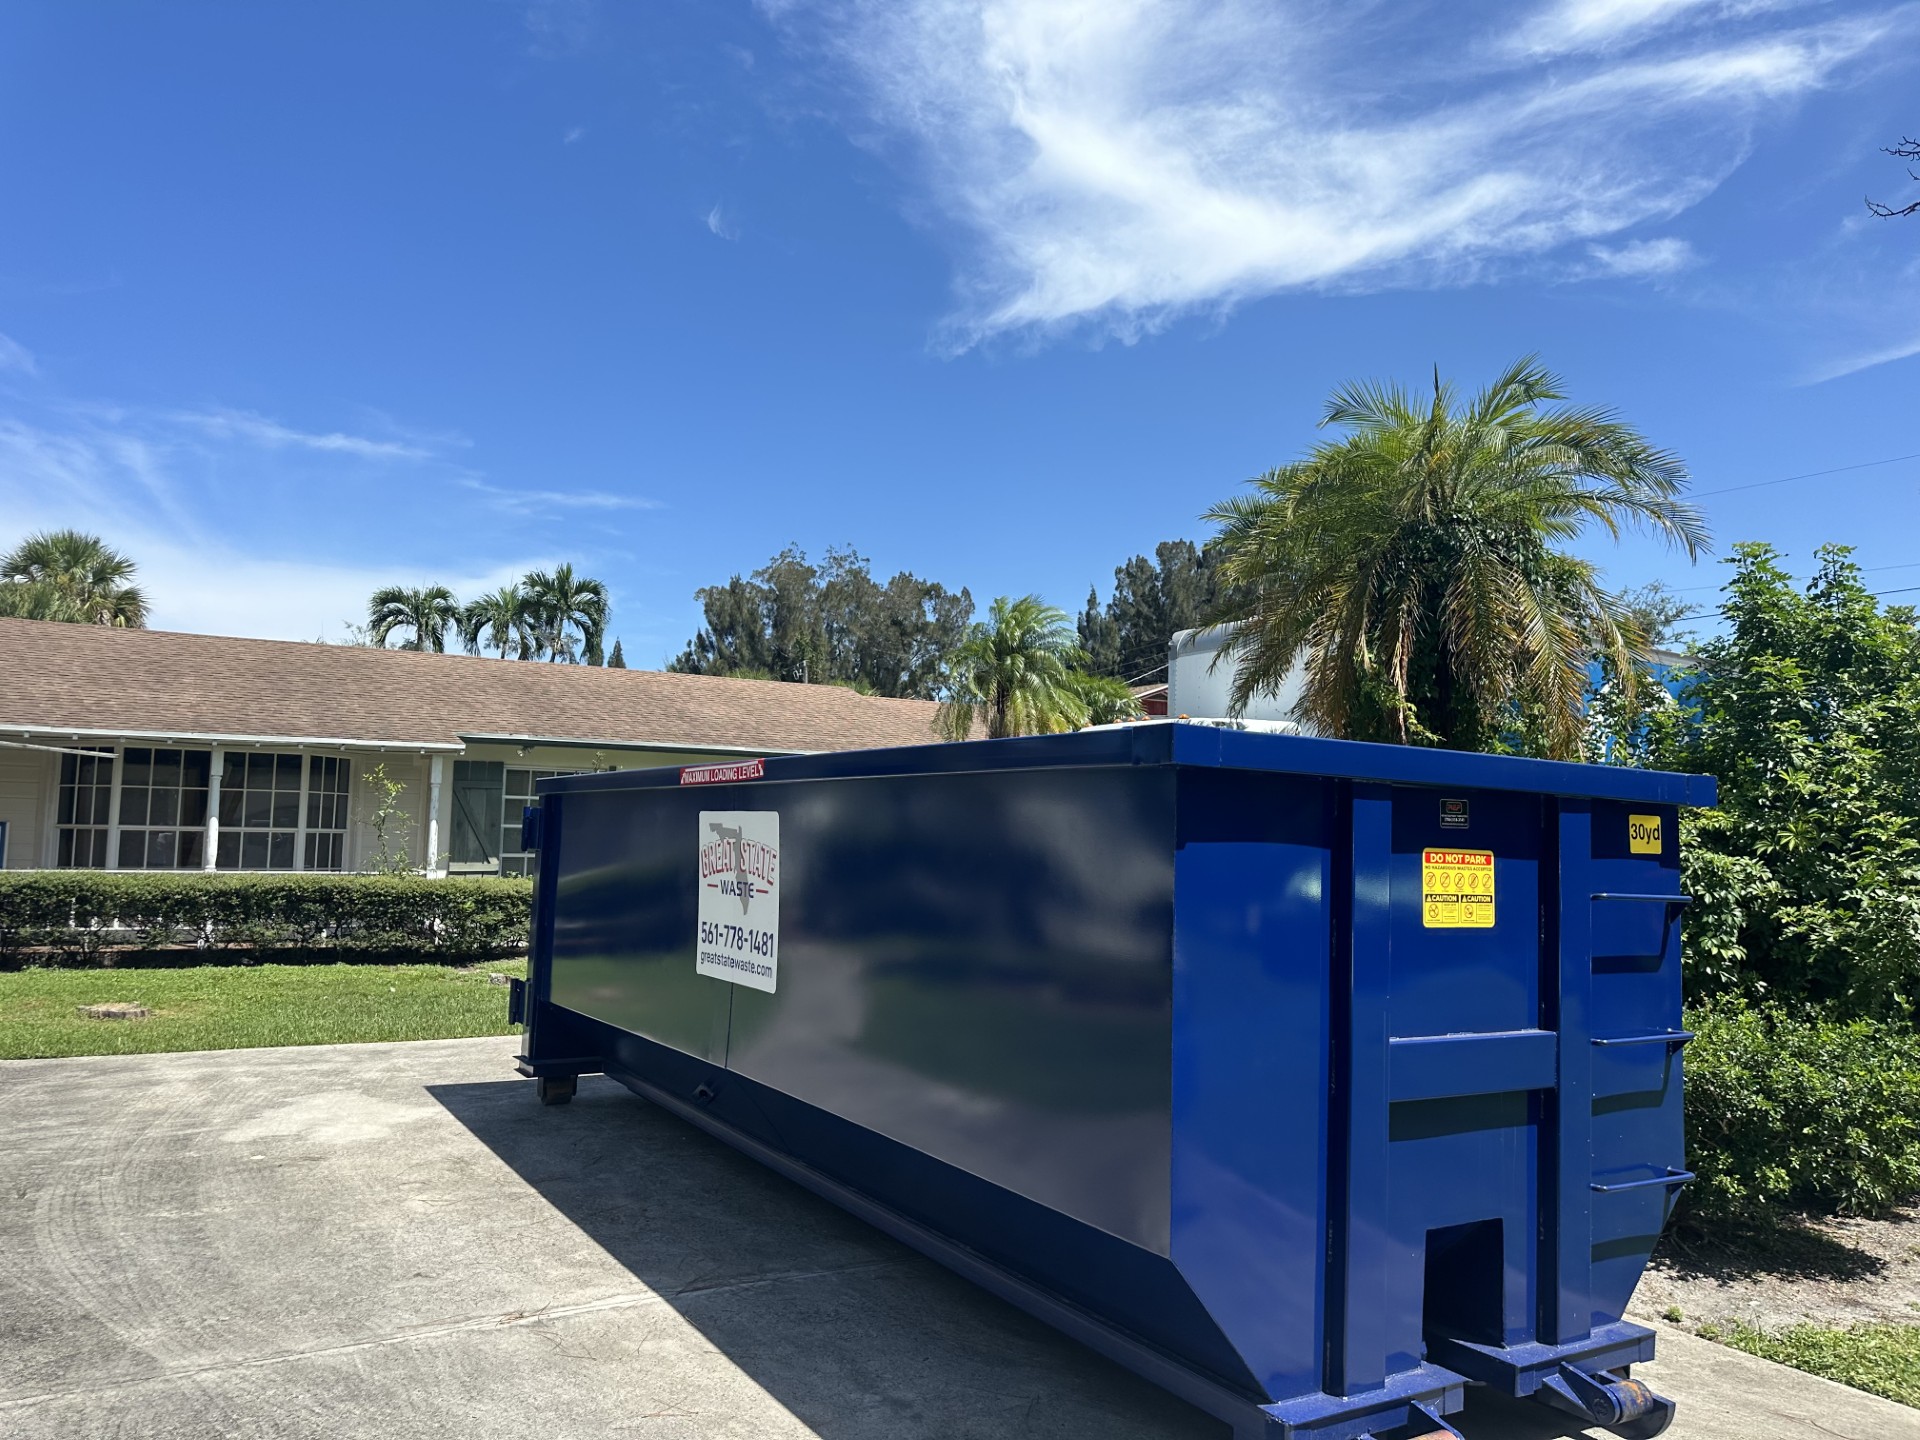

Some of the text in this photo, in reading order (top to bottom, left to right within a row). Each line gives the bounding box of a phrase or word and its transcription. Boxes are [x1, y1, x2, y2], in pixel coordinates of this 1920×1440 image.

[683, 763, 759, 783] MAXIMUM LOADING LEVEL
[1630, 823, 1661, 845] 30yd
[701, 837, 777, 887] GREAT STATE
[1430, 853, 1487, 864] DO NOT PARK
[720, 879, 754, 899] WASTE
[1466, 895, 1491, 903] CAUTION
[701, 921, 774, 958] 561-778-1481
[700, 951, 773, 979] greatstatewaste.com
